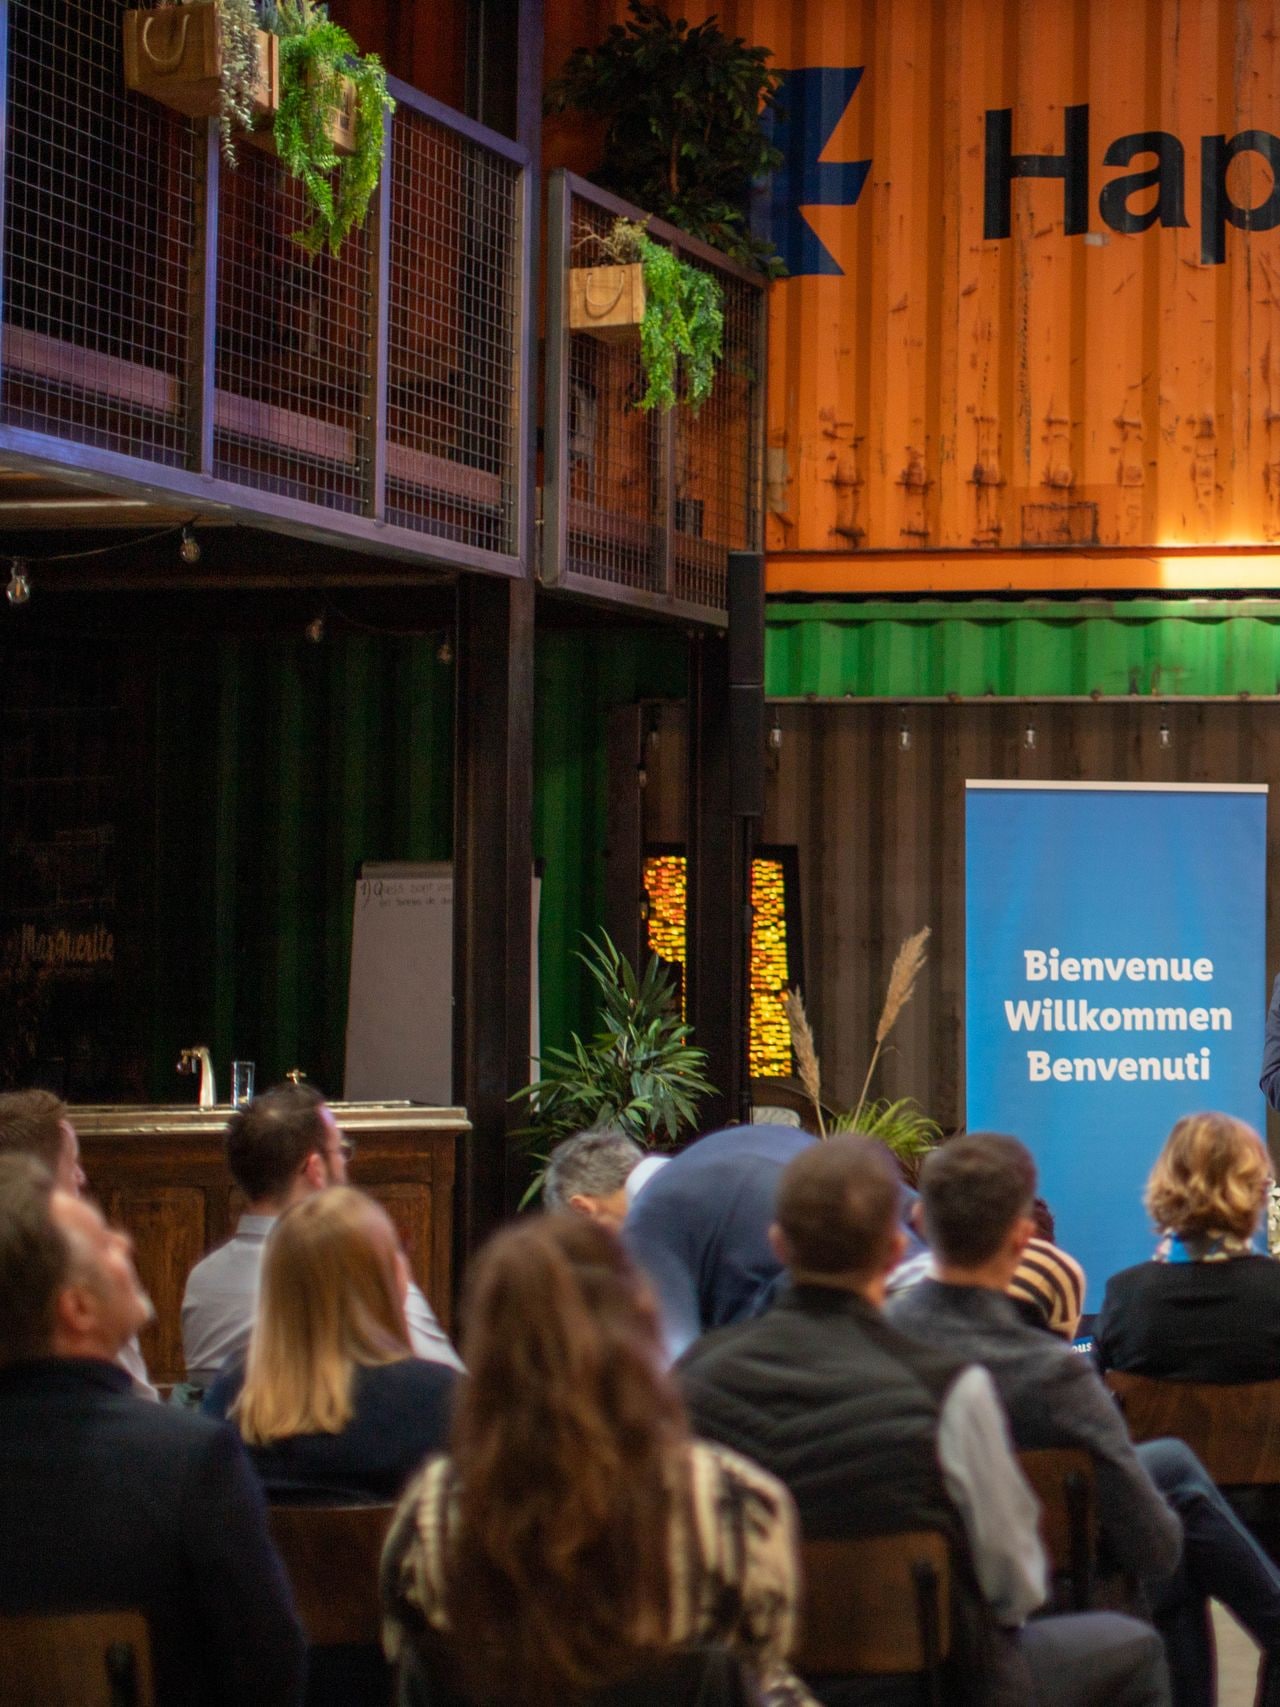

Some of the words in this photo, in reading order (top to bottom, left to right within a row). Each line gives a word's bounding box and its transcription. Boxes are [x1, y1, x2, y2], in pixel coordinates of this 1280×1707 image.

[1023, 947, 1214, 982] Bienvenue
[1004, 998, 1233, 1032] Willkommen
[1026, 1047, 1211, 1082] Benvenuti
